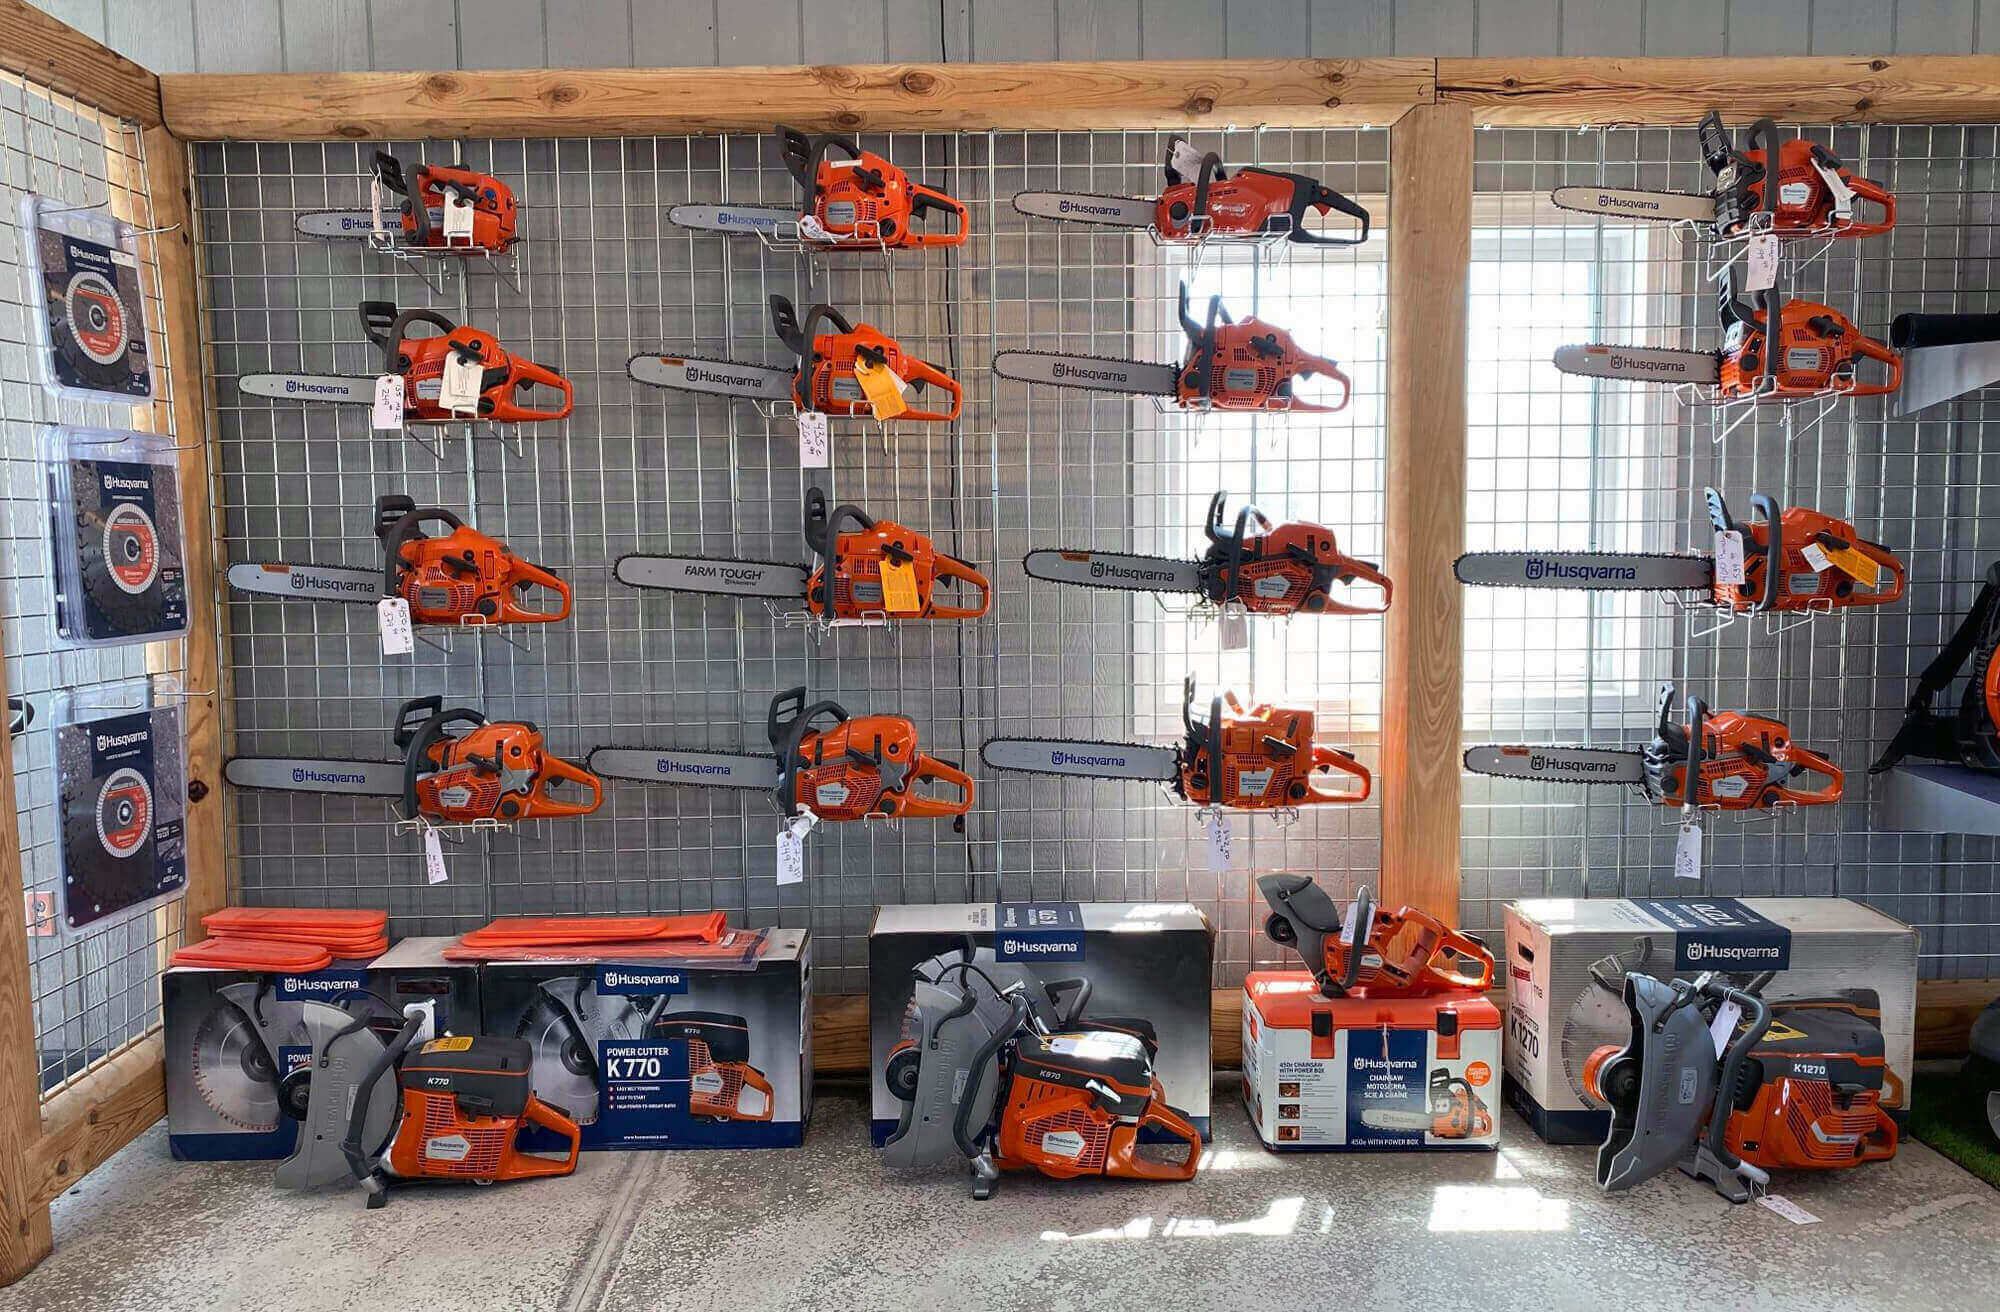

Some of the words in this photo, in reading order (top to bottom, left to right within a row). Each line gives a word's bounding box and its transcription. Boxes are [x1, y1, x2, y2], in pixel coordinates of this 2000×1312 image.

[1070, 202, 1121, 217] Husqvarna
[1609, 197, 1659, 211] Husqvarna
[352, 219, 402, 229] Husarna
[727, 214, 777, 226] Husqvarna
[77, 249, 110, 265] Husqvarna
[1623, 358, 1686, 373] Husqvarna
[699, 370, 762, 388] Husqvarna
[1065, 366, 1128, 383] Husqvarna
[297, 383, 349, 395] Husqvarna
[112, 477, 149, 490] Husqvarna
[684, 564, 716, 578] FARM
[719, 566, 763, 580] TOUGH
[1105, 564, 1175, 583] Husqvarna
[1545, 562, 1636, 581] Husqvarna
[305, 577, 375, 594] Husqvarna
[107, 730, 148, 748] Husqvarna
[670, 761, 731, 776] Husqvarna
[1064, 753, 1126, 769] Husqvarna
[1545, 756, 1617, 773] Husqvarna
[305, 770, 366, 785] Husqvarna
[1017, 941, 1077, 954] Husqvarna
[1703, 945, 1780, 960] Husqvarna
[297, 979, 360, 993] Husqvarna
[618, 973, 680, 986] Husqvarna
[606, 1047, 636, 1057] POWER
[637, 1047, 670, 1057] CUTTER
[607, 1058, 621, 1078] K
[623, 1057, 661, 1078] 770
[427, 1077, 450, 1086] K770
